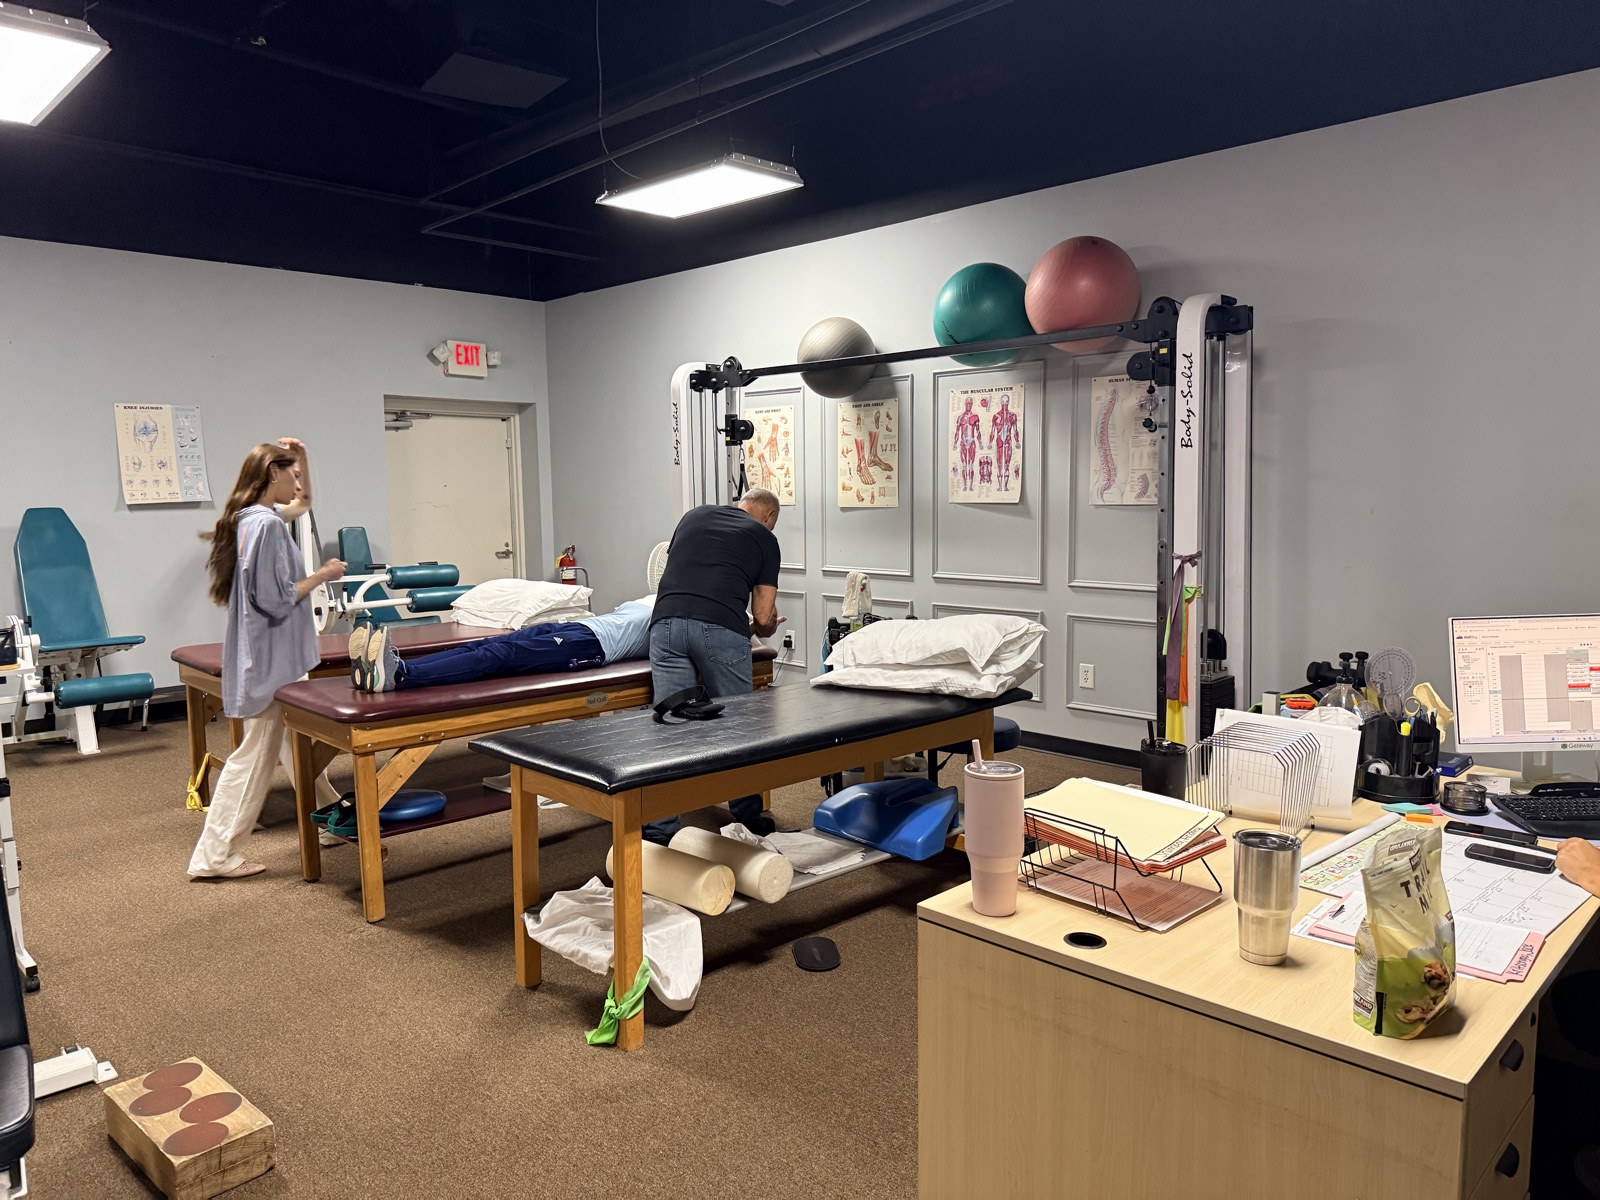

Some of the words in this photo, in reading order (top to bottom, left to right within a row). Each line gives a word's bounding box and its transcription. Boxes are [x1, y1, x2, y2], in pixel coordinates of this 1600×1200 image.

[455, 343, 481, 367] EXIT
[1180, 351, 1196, 449] Body-Solid
[672, 401, 681, 466] Body-Solid
